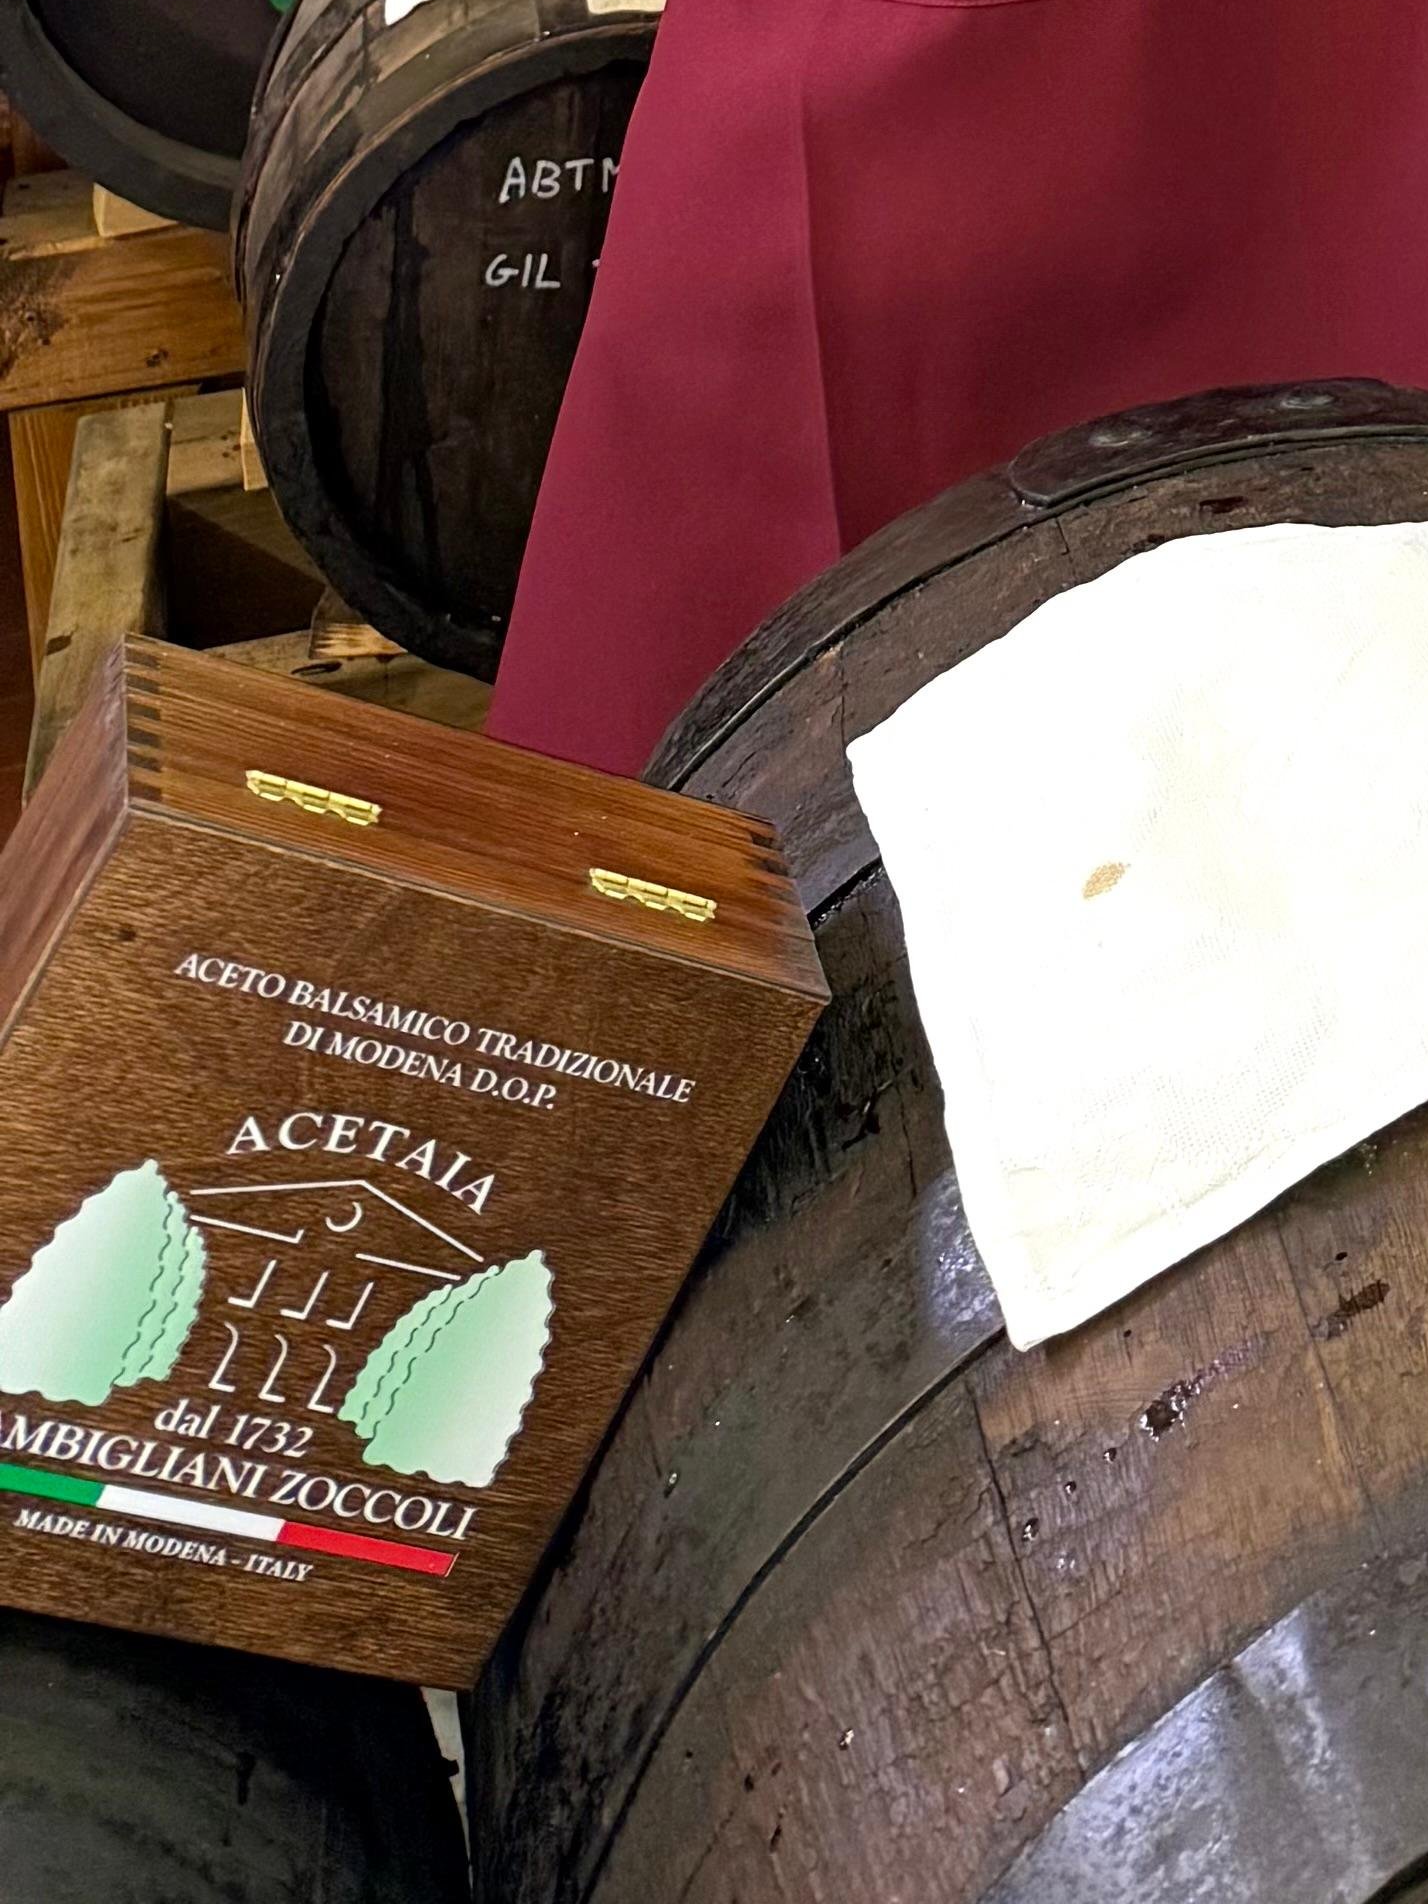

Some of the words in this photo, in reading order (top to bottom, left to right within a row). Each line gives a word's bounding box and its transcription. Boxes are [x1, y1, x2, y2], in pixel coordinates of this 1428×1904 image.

[485, 253, 561, 289] GIL
[174, 953, 286, 999] ACETO
[288, 980, 472, 1046] BALSAMICO
[475, 1027, 696, 1104] TRADIZIONALE
[283, 1021, 322, 1052] DI
[325, 1032, 463, 1089] MODENA
[470, 1067, 558, 1111] D.O.P.
[225, 1110, 501, 1216] ACETAIA
[154, 1398, 216, 1441] dal
[228, 1414, 315, 1458] 1732
[2, 1413, 268, 1499] MBIGLIANI
[269, 1469, 479, 1541] ZOCCOLI
[13, 1508, 88, 1538] MADE
[95, 1523, 121, 1546] IN
[123, 1530, 227, 1568] MODENA
[245, 1554, 314, 1583] ITALY
